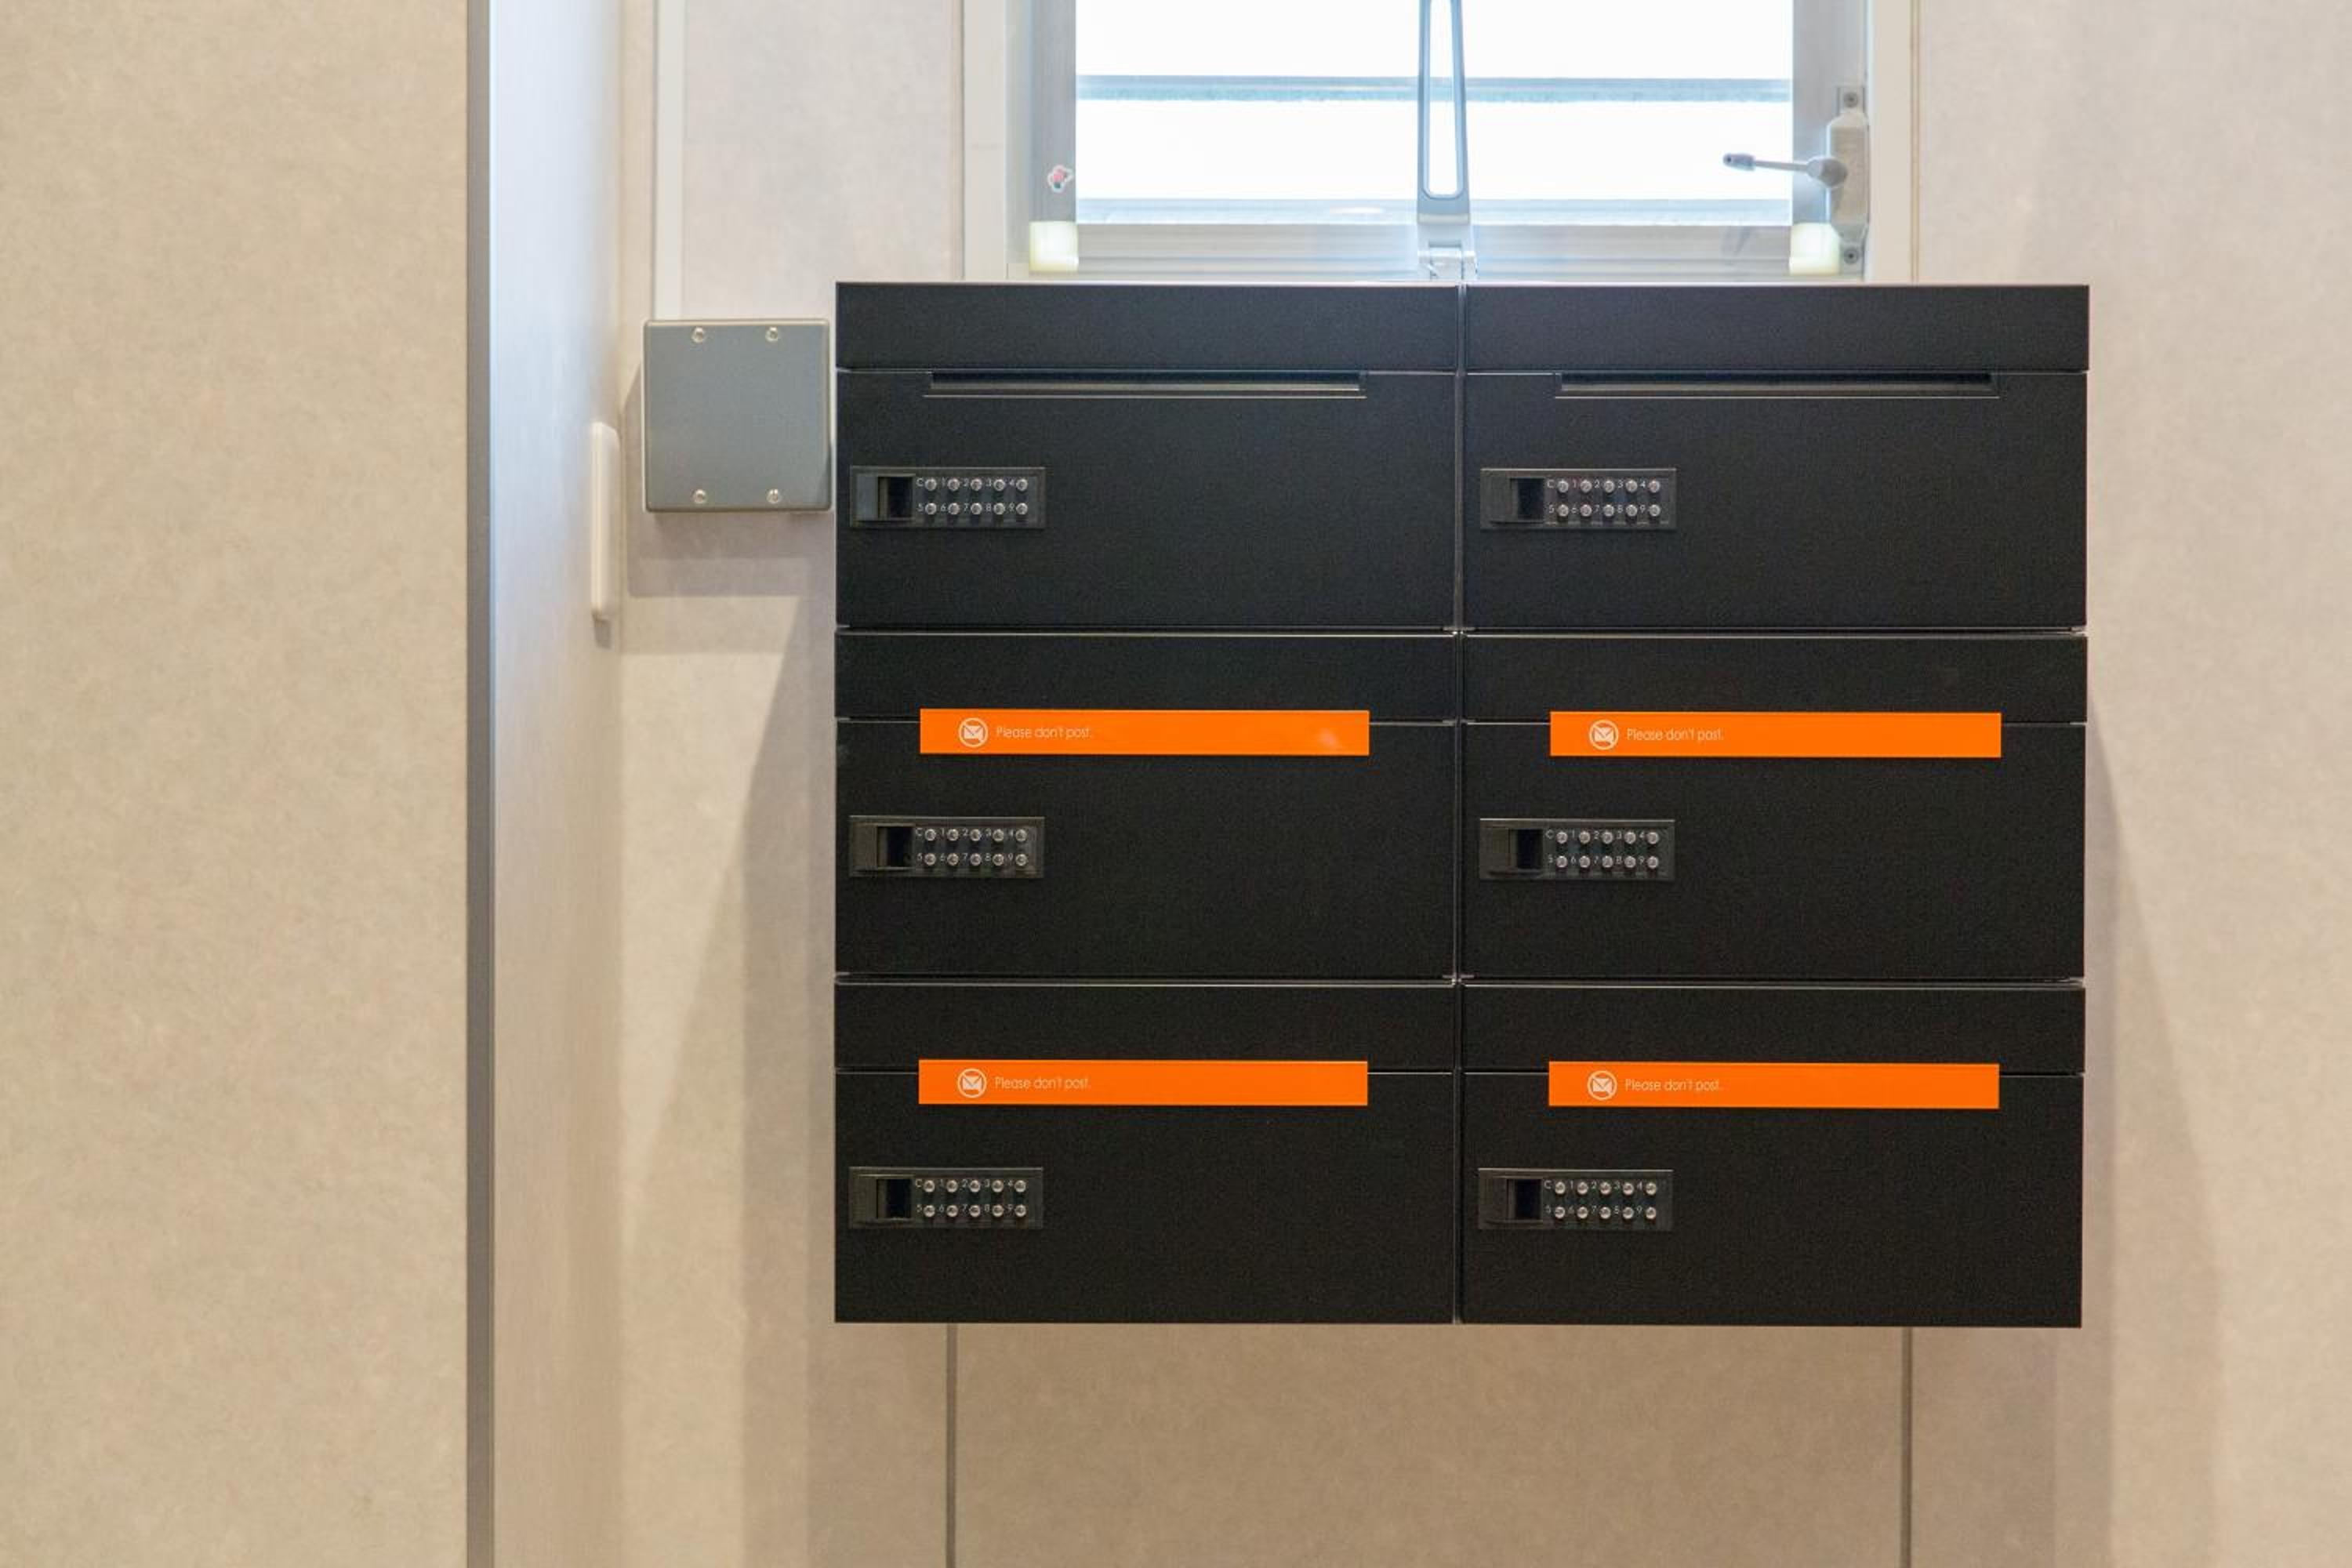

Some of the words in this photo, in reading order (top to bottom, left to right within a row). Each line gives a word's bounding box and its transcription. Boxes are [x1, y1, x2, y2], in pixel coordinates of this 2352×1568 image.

[996, 726, 1031, 738] Please
[1035, 727, 1064, 738] don't
[1066, 728, 1091, 741] post.
[1627, 728, 1662, 740] Please
[1667, 728, 1694, 740] don't
[1697, 728, 1723, 743] post.
[995, 1077, 1029, 1089] Please
[1034, 1077, 1062, 1088] don't
[1065, 1077, 1091, 1091] post.
[1625, 1079, 1659, 1091] Please
[1664, 1079, 1693, 1091] don't
[1695, 1080, 1721, 1093] post.
